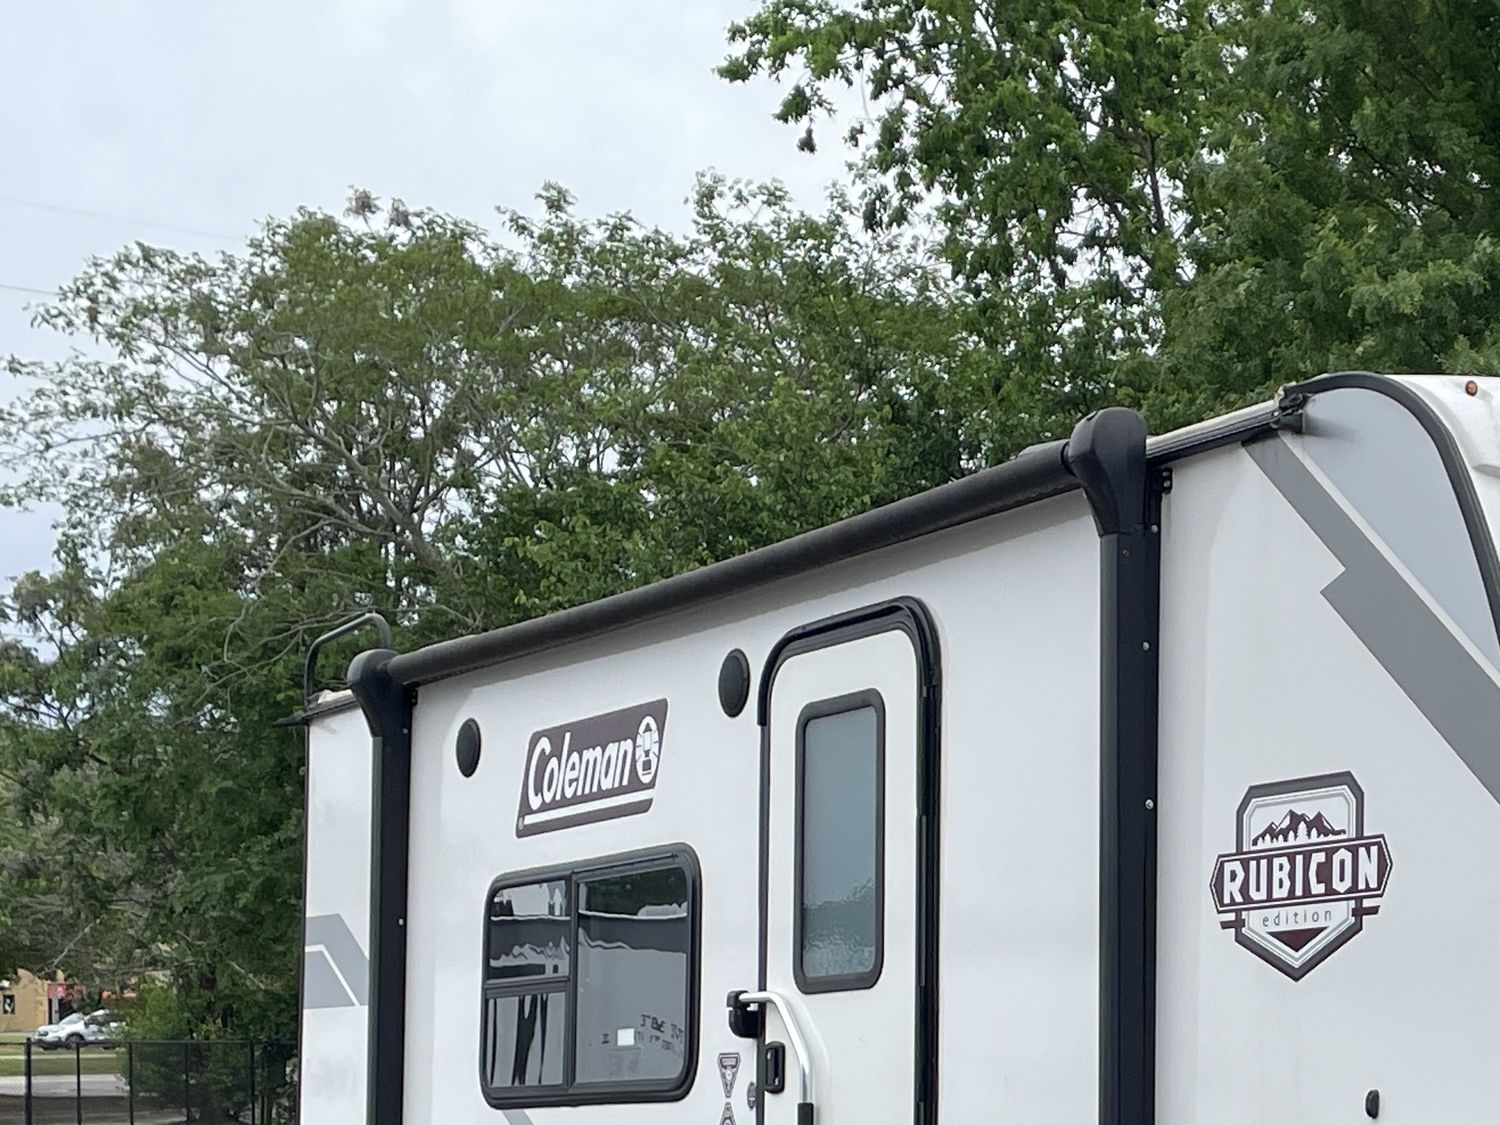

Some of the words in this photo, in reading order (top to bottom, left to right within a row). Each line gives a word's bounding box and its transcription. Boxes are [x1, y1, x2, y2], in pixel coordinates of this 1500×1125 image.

[528, 731, 634, 811] Coleman
[1223, 845, 1379, 904] RUBICON
[1262, 908, 1332, 927] edition
